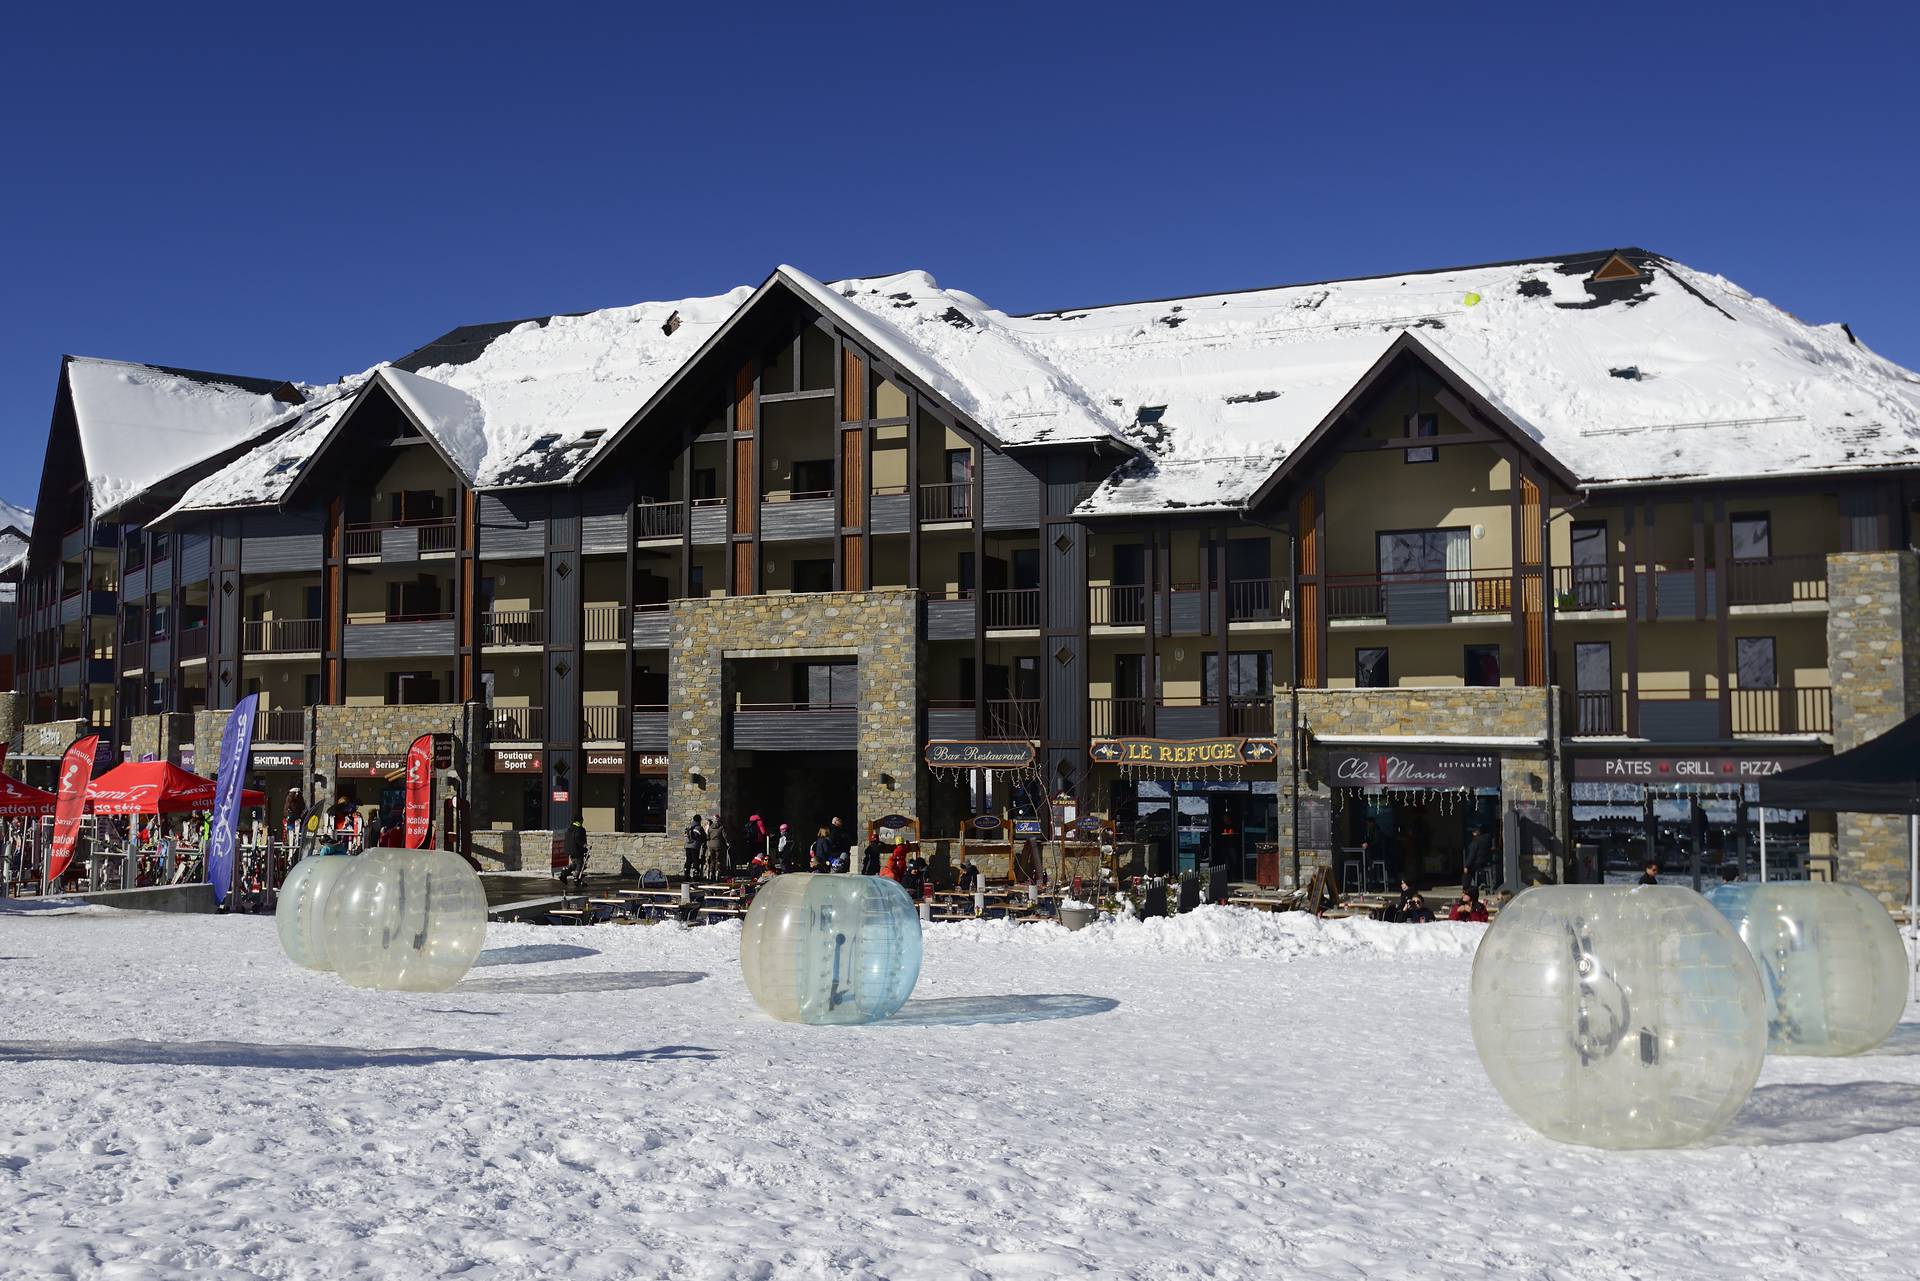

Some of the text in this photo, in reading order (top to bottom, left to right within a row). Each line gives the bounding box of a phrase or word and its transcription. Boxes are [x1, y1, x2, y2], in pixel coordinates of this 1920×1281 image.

[498, 751, 533, 760] Boutique
[933, 746, 1026, 760] Bar Restaurant
[1129, 743, 1236, 762] LE REFUGE
[340, 760, 369, 769] Location
[588, 756, 623, 764] Location
[642, 756, 652, 764] de
[504, 760, 526, 770] Sport
[1337, 756, 1448, 779] Chez Manu
[1605, 759, 1783, 775] PÂTES GRILL PIZZA
[94, 803, 112, 812] de
